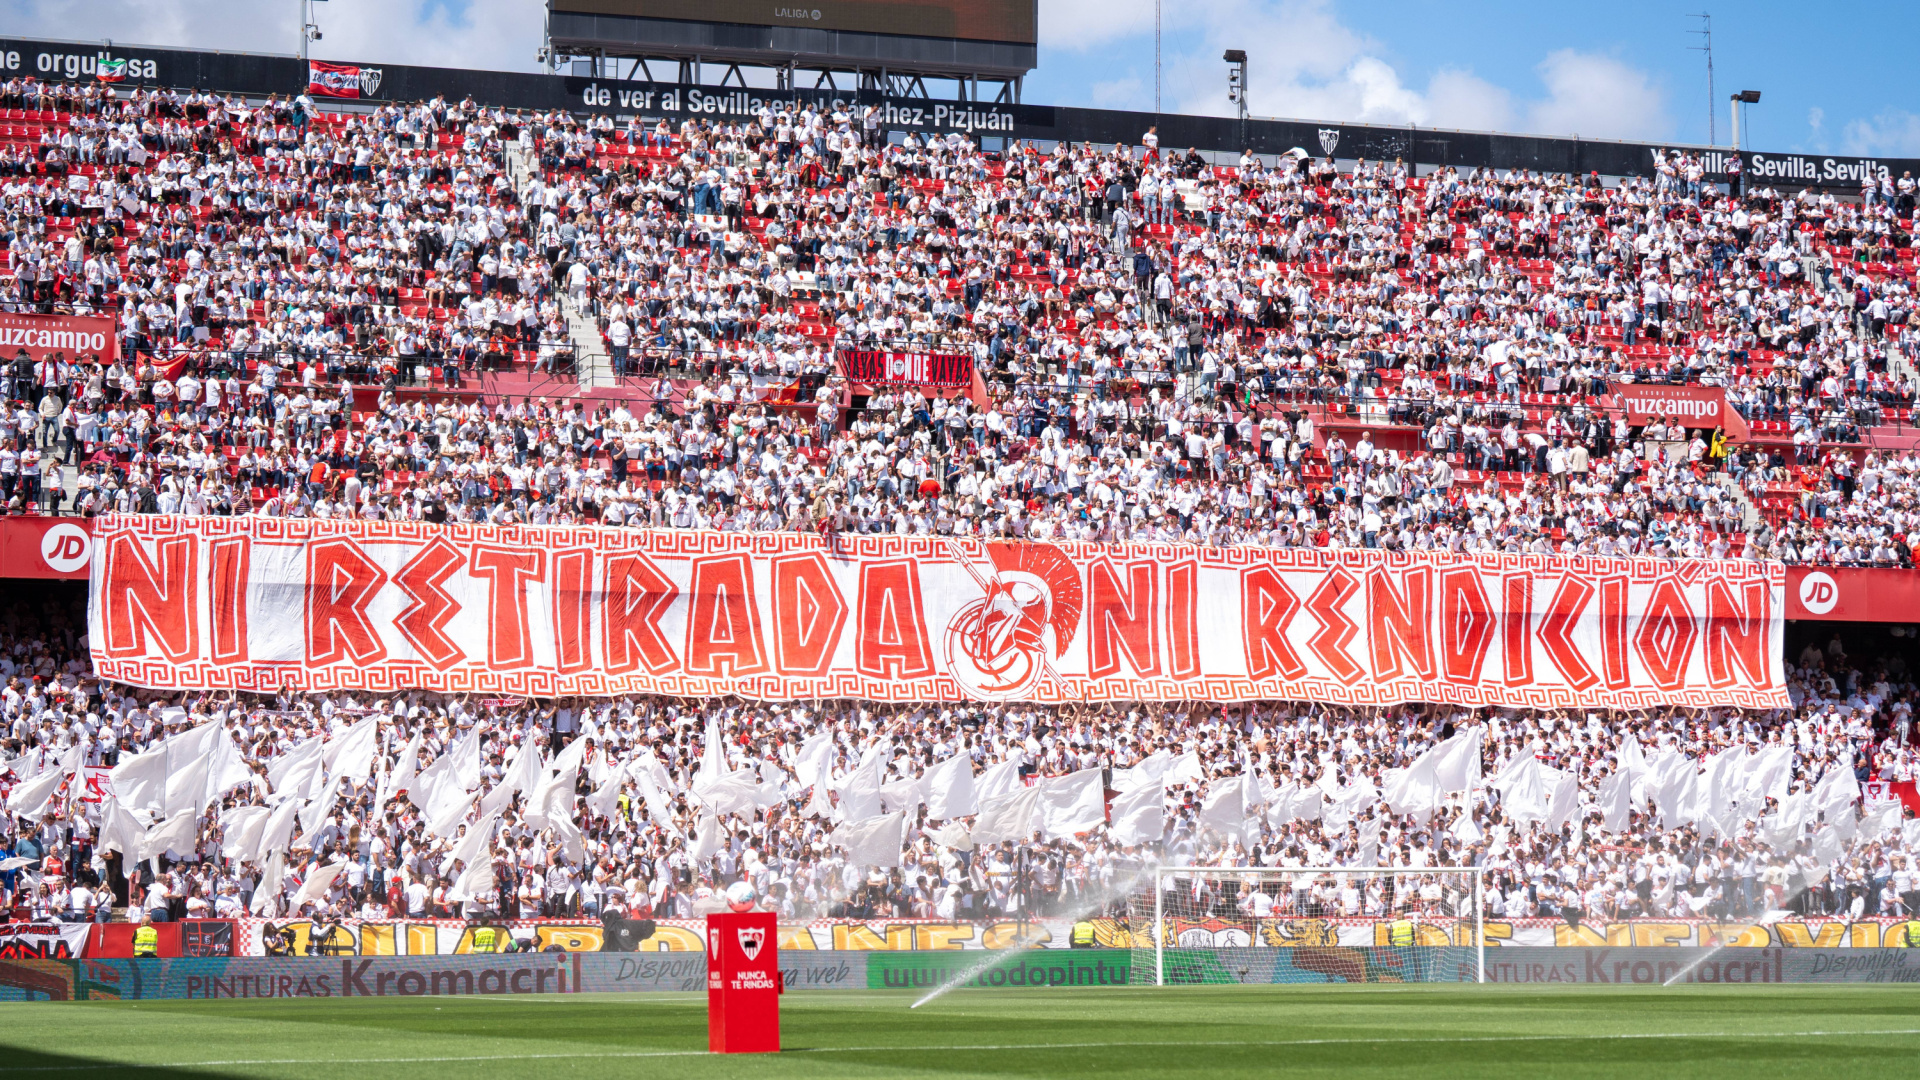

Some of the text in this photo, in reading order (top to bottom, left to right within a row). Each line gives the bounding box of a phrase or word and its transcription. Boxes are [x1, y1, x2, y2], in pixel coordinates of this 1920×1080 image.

[774, 7, 809, 18] LALIGA
[0, 50, 157, 78] e orgusa
[583, 83, 611, 107] de
[618, 88, 655, 109] ver
[661, 88, 680, 112] al
[687, 89, 762, 116] Sevilla
[831, 98, 1014, 133] Sáhez-Pizjuán
[845, 352, 885, 378] VAYAS
[930, 355, 971, 383] VAYAS
[1613, 391, 1719, 419] Cruzcampo
[48, 535, 85, 559] JD
[1805, 582, 1833, 604] JD
[101, 529, 1773, 692] NI RETIRADA NI RENDICIÓN
[187, 953, 581, 999] PINTURAS Kromacril
[737, 970, 767, 980] NUNCA
[806, 959, 850, 984] web
[1585, 949, 1783, 984] Kromacril
[1811, 950, 1908, 978] Disponible
[731, 980, 742, 989] TE
[743, 979, 775, 989] RINDAS
